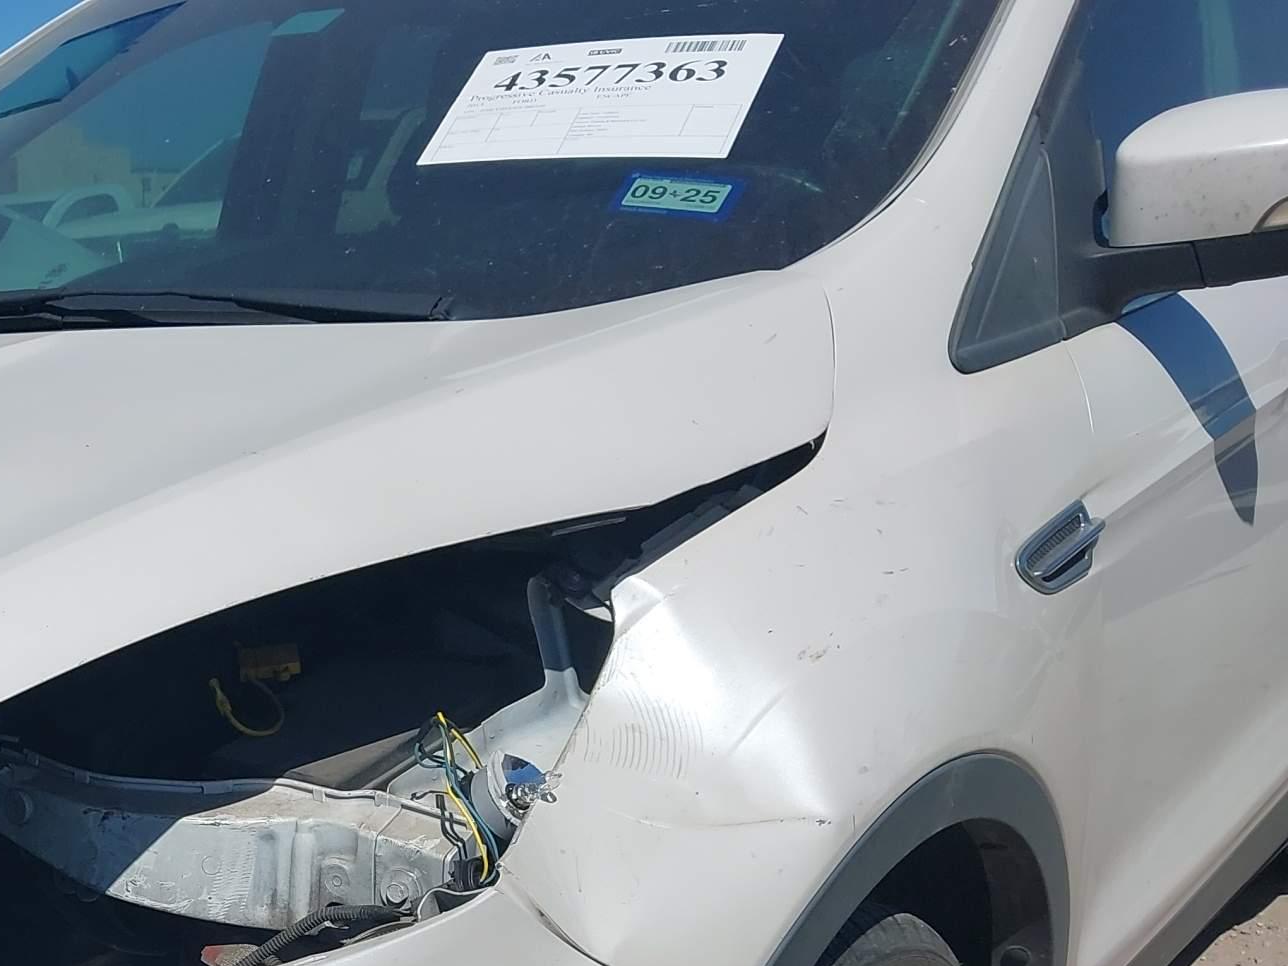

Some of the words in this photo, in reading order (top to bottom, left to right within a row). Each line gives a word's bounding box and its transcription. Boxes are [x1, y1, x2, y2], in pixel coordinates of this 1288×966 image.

[493, 60, 729, 92] 43577363
[470, 91, 536, 103] Progressive
[539, 86, 589, 97] Casualty
[593, 83, 653, 94] Insurance
[630, 184, 668, 200] 09
[680, 188, 721, 204] 25
